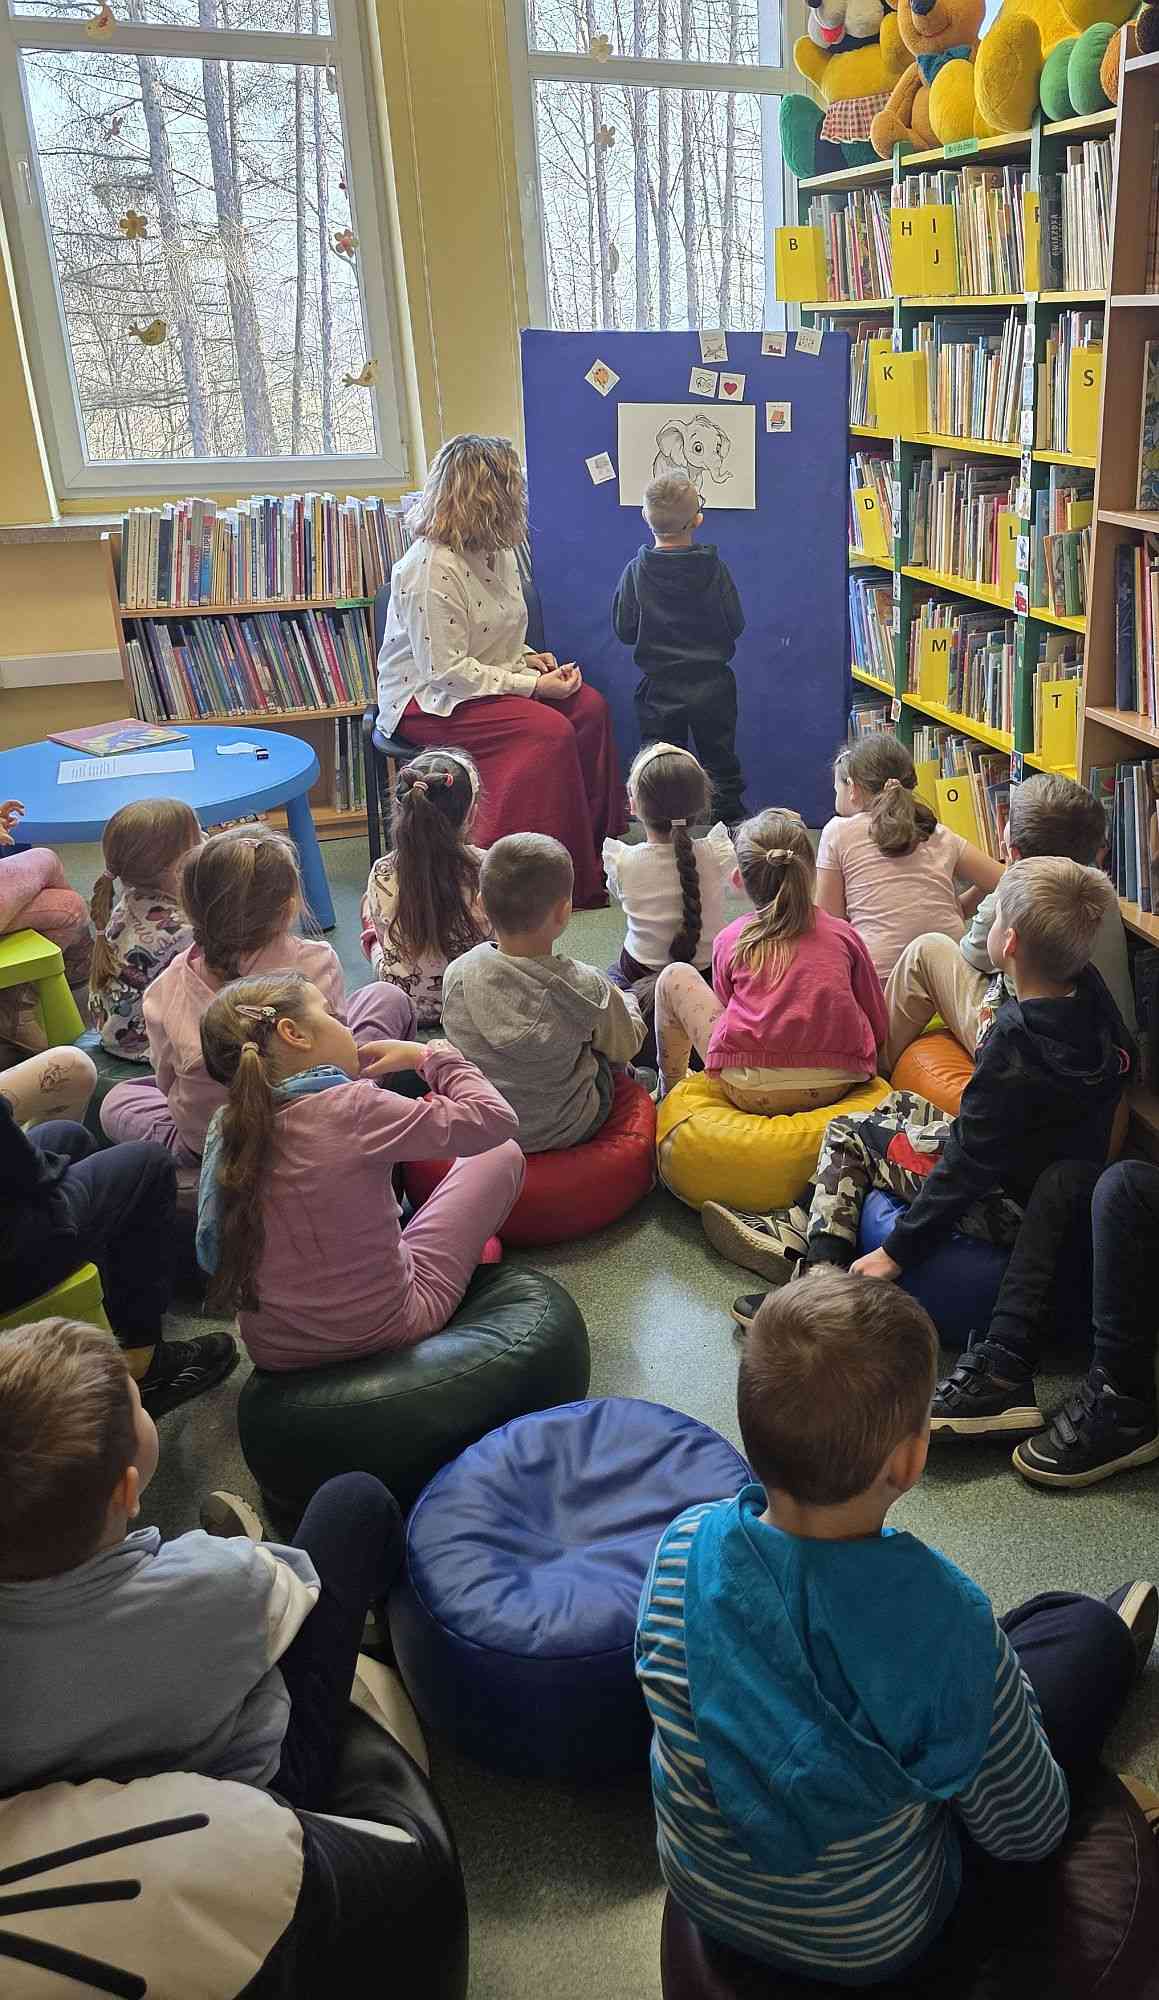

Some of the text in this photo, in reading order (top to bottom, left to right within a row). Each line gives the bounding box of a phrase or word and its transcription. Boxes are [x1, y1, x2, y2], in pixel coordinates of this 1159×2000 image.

[901, 220, 913, 236] H
[932, 218, 937, 234] I
[788, 238, 799, 251] B
[933, 249, 940, 265] J
[883, 365, 894, 381] K
[1083, 369, 1094, 387] S
[863, 498, 875, 511] D
[1008, 526, 1018, 541] L
[931, 638, 947, 653] M
[1051, 694, 1063, 709] T
[946, 788, 959, 802] O
